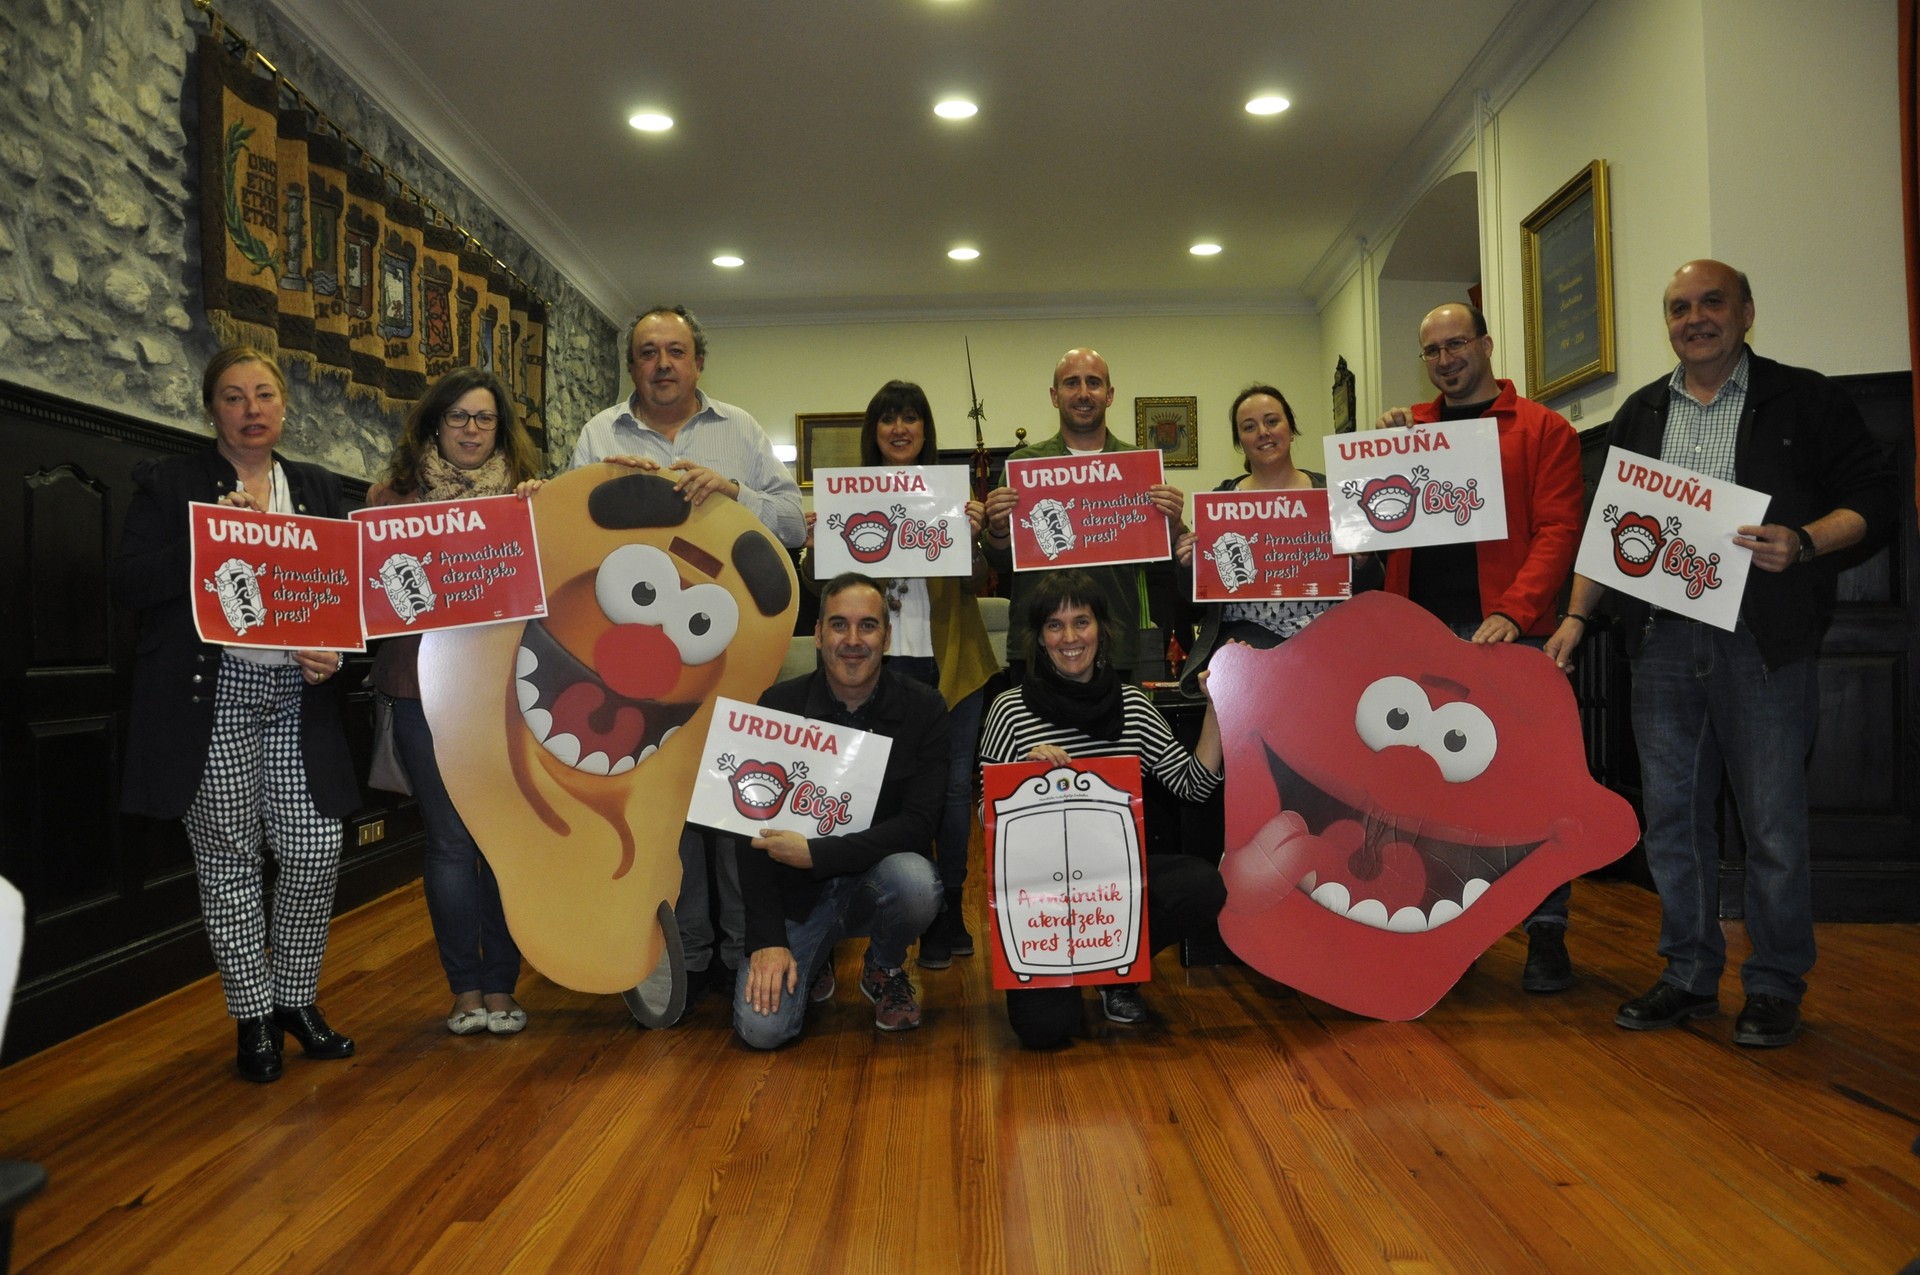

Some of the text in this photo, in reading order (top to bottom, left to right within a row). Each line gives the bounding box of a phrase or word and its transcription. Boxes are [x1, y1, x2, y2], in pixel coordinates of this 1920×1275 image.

[1338, 428, 1451, 461] URDUÑA
[827, 471, 927, 495] URDUÑA
[1020, 460, 1123, 488] URDUÑA
[1616, 459, 1713, 512] URDUÑA
[1206, 496, 1308, 521] URDUÑA
[1422, 478, 1485, 526] bizi
[366, 507, 486, 542] URDUÑA
[1081, 509, 1147, 530] ateratzeko
[207, 518, 318, 551] URDUÑA
[898, 518, 953, 561] bizi
[1082, 529, 1118, 548] prest!
[1264, 548, 1330, 566] ateratzeko
[1662, 537, 1723, 600] bizi
[441, 561, 517, 586] ateratzeko
[1264, 565, 1299, 584] prest!
[273, 585, 341, 610] ateratzeko
[444, 585, 484, 609] prest!
[273, 606, 311, 627] prest!
[728, 710, 838, 755] URDUÑA
[789, 780, 853, 836] bizi
[1027, 907, 1116, 934] ateratzeko
[1021, 929, 1123, 958] prest zaude?
